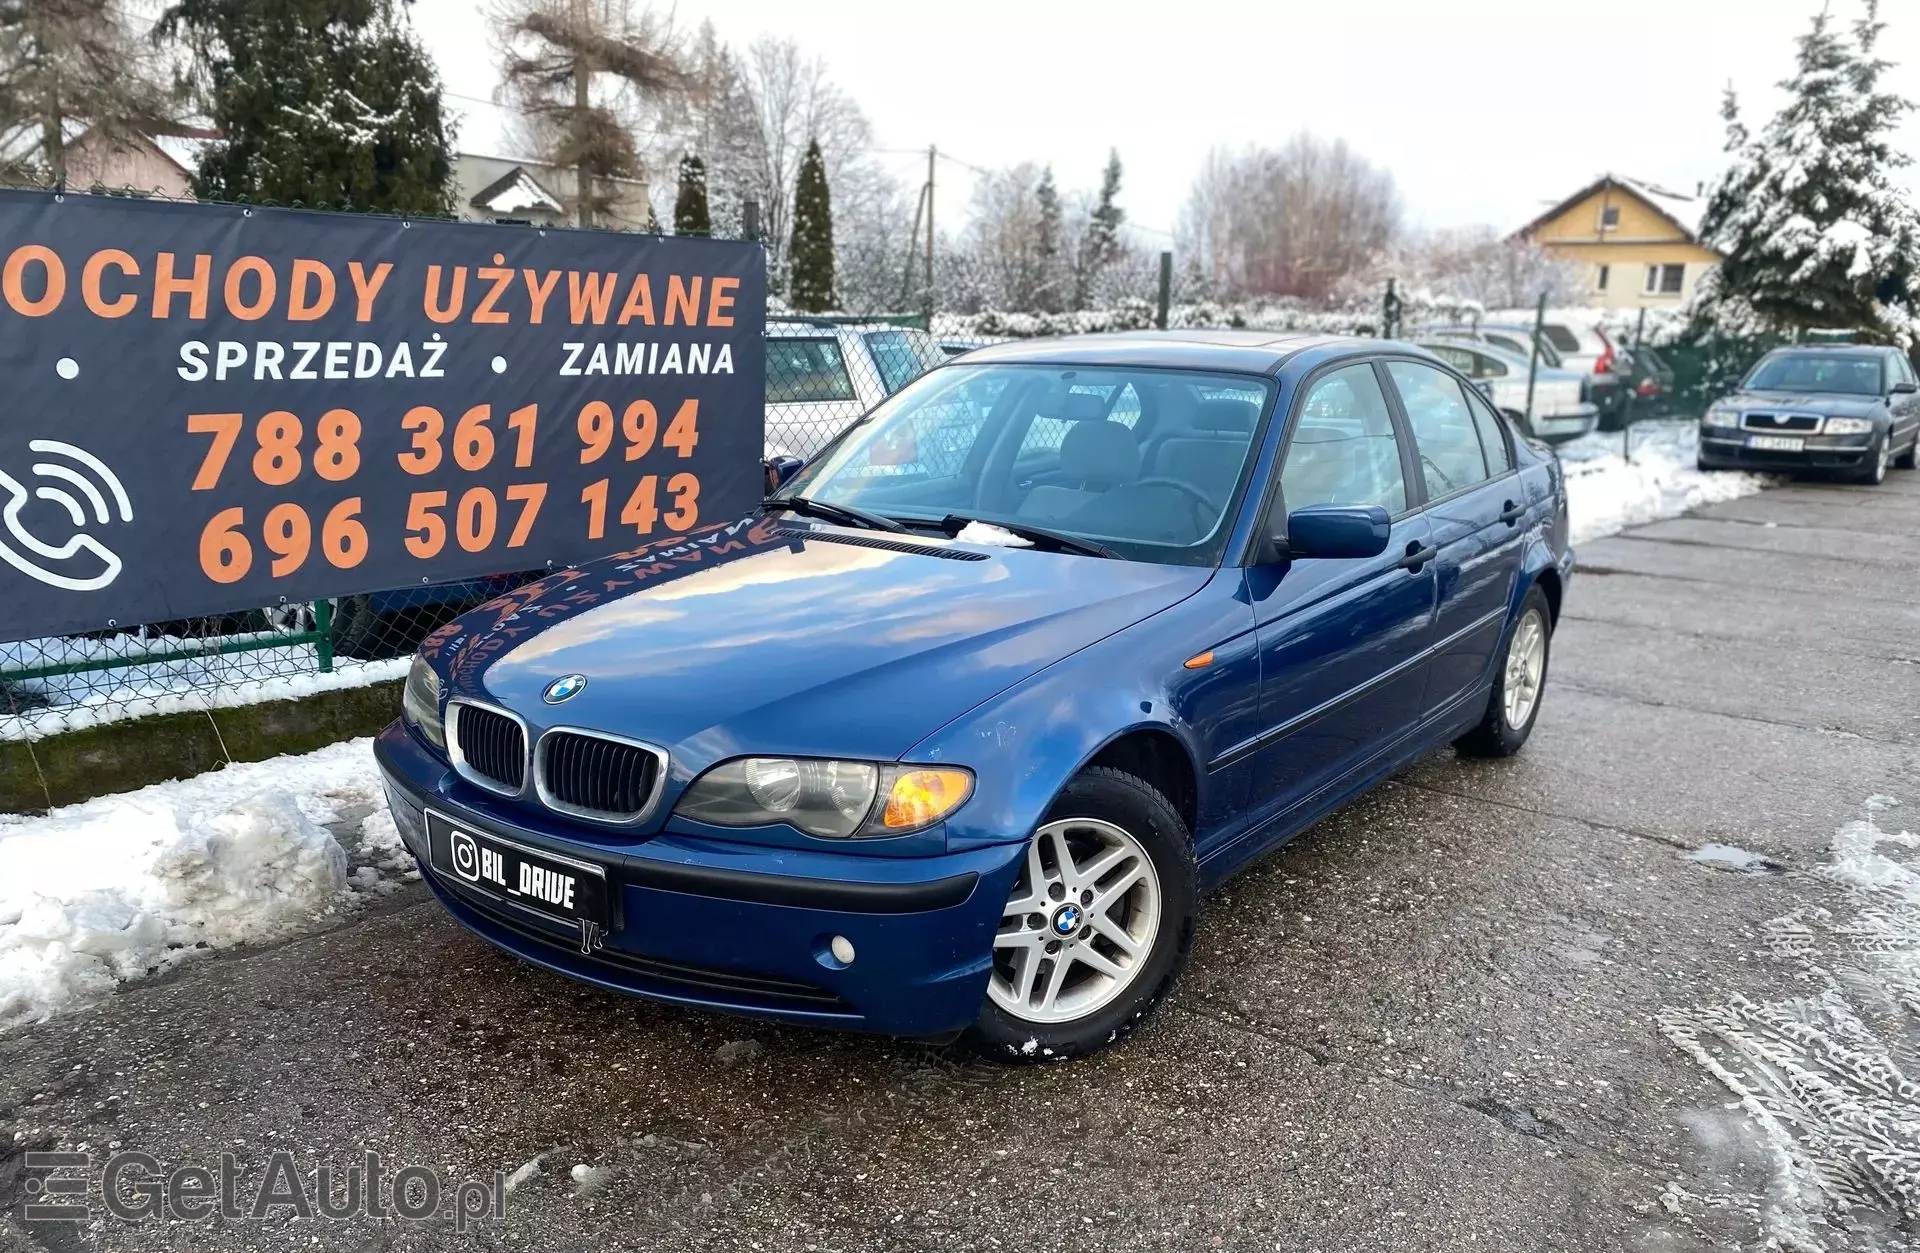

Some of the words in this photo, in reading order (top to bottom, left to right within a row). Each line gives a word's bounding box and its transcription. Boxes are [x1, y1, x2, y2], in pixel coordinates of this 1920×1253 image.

[2, 245, 393, 322] OCHODY
[424, 253, 740, 327] UŻYWANE
[177, 332, 449, 382] SPRZEDAŻ
[559, 342, 735, 376] ZAMIANA
[187, 410, 362, 490] 788
[398, 404, 538, 476] 361
[577, 399, 699, 465] 994
[199, 496, 369, 582] 696
[404, 483, 548, 559] 507
[581, 472, 700, 540] 143
[481, 847, 576, 910] BIL_DRIVE
